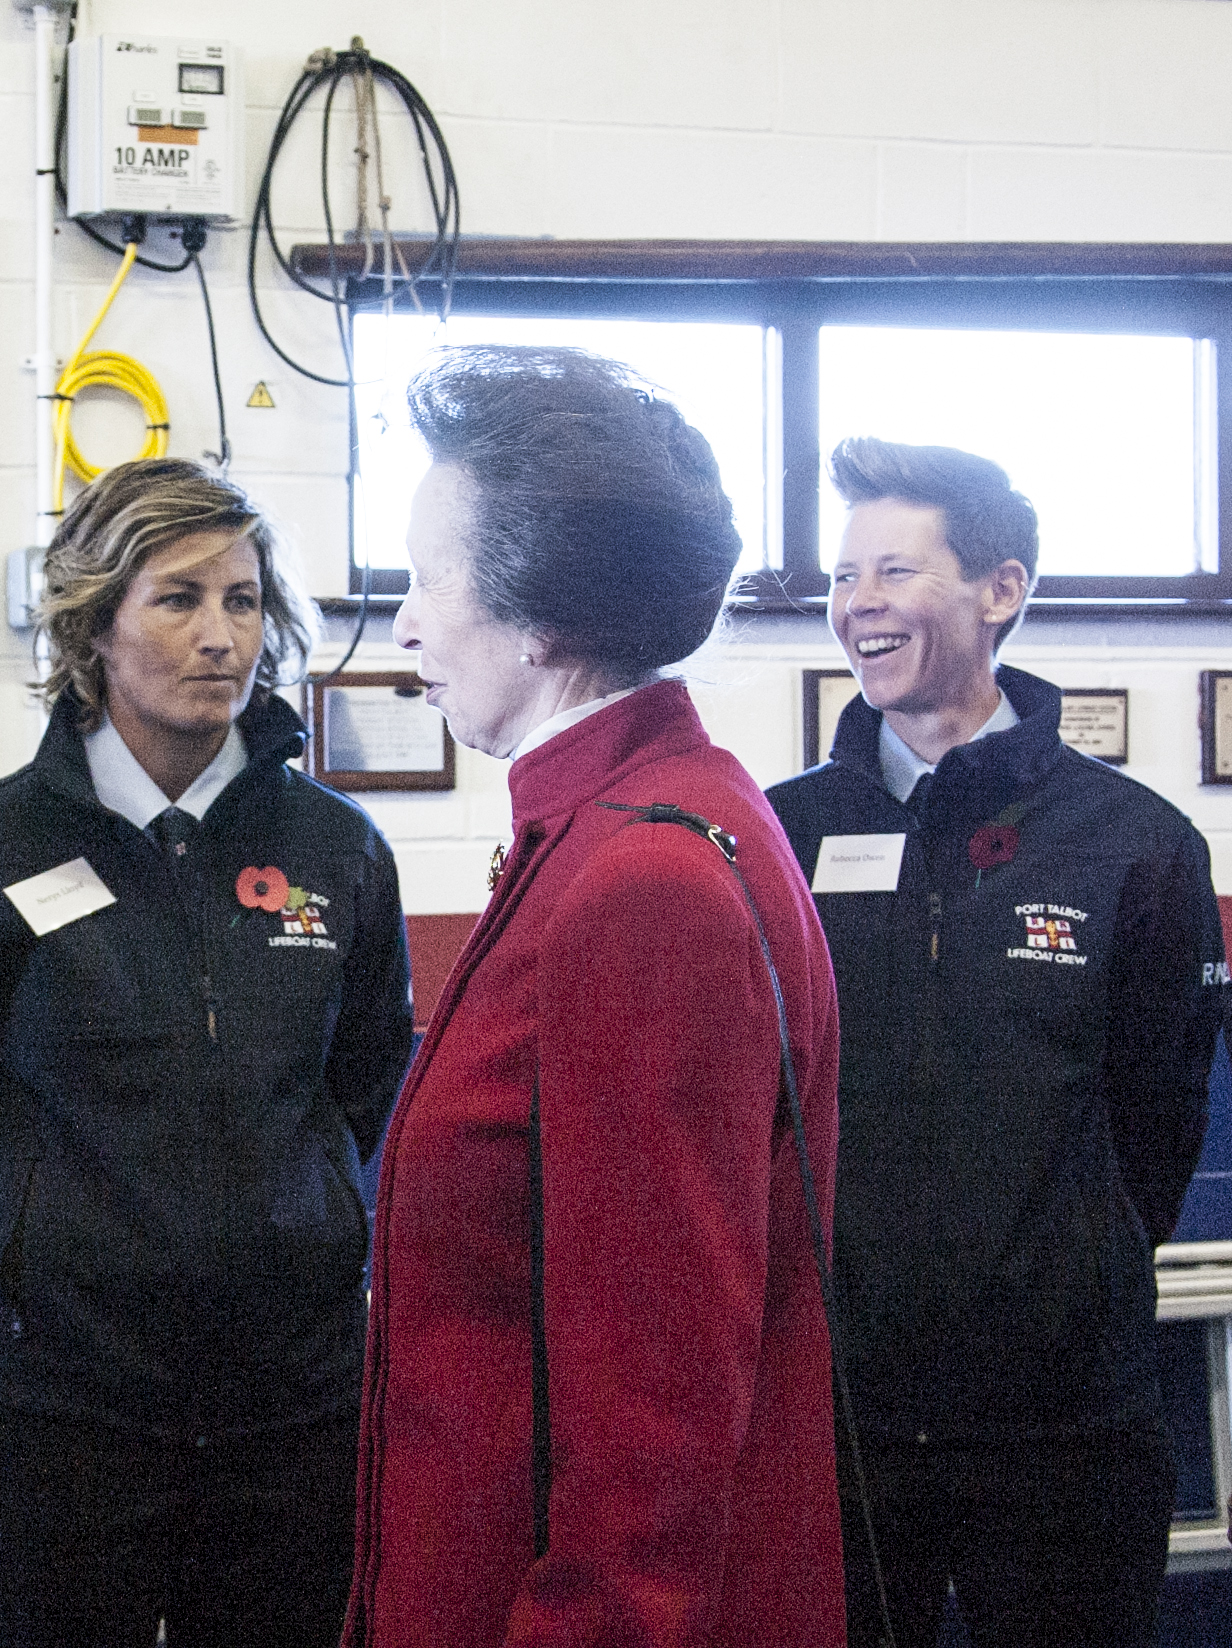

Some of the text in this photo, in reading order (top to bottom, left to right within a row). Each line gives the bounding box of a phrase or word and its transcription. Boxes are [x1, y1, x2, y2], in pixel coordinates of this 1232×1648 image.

[115, 146, 190, 168] 10 AMP
[1014, 903, 1088, 922] PORT TALBOT
[268, 936, 311, 947] LIFEBOAT
[1007, 947, 1088, 966] LIFEBOAT CREW
